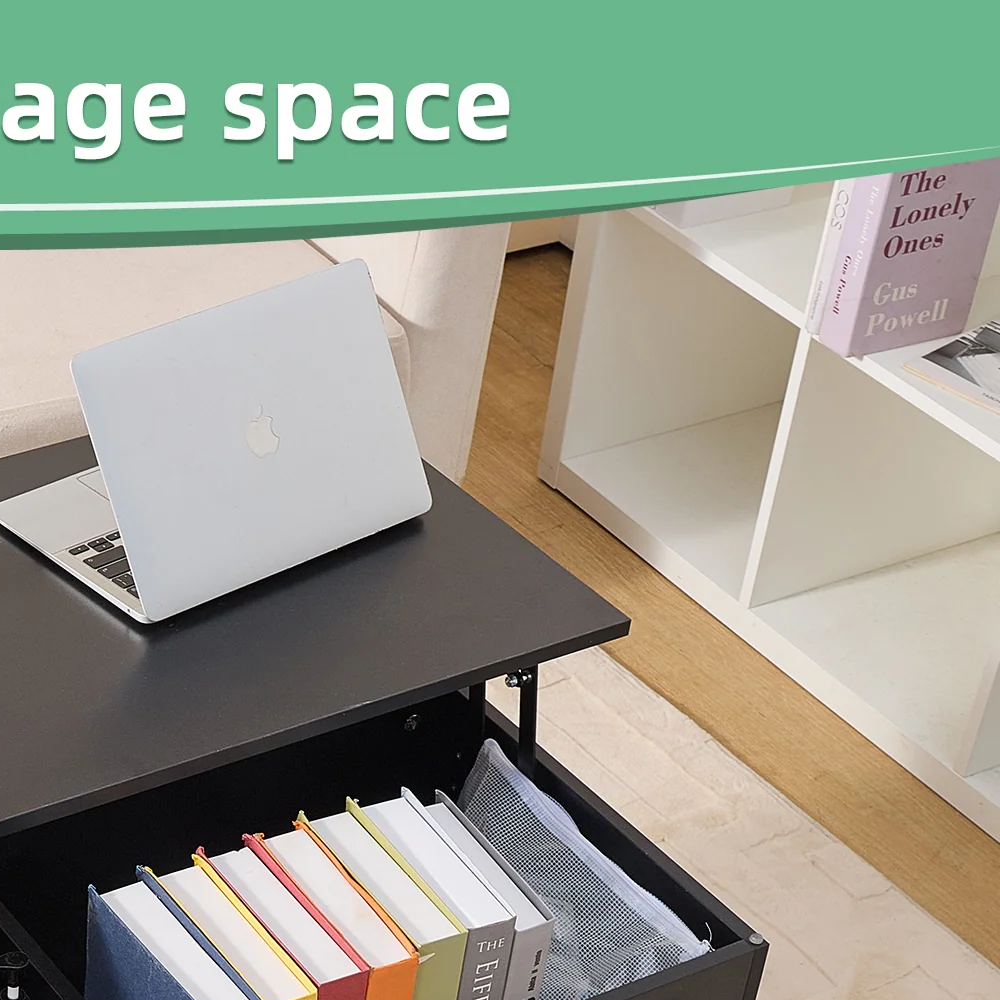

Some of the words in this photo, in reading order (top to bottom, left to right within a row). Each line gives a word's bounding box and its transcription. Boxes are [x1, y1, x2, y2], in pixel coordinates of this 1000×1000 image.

[901, 170, 946, 197] The
[831, 189, 849, 231] COS
[889, 193, 976, 229] Lonely
[860, 208, 874, 244] Lonely
[884, 232, 944, 259] Ones
[842, 255, 852, 275] Gus
[832, 278, 847, 315] Powell
[873, 281, 918, 306] Gus
[865, 298, 949, 337] Powell
[477, 938, 505, 953] THE
